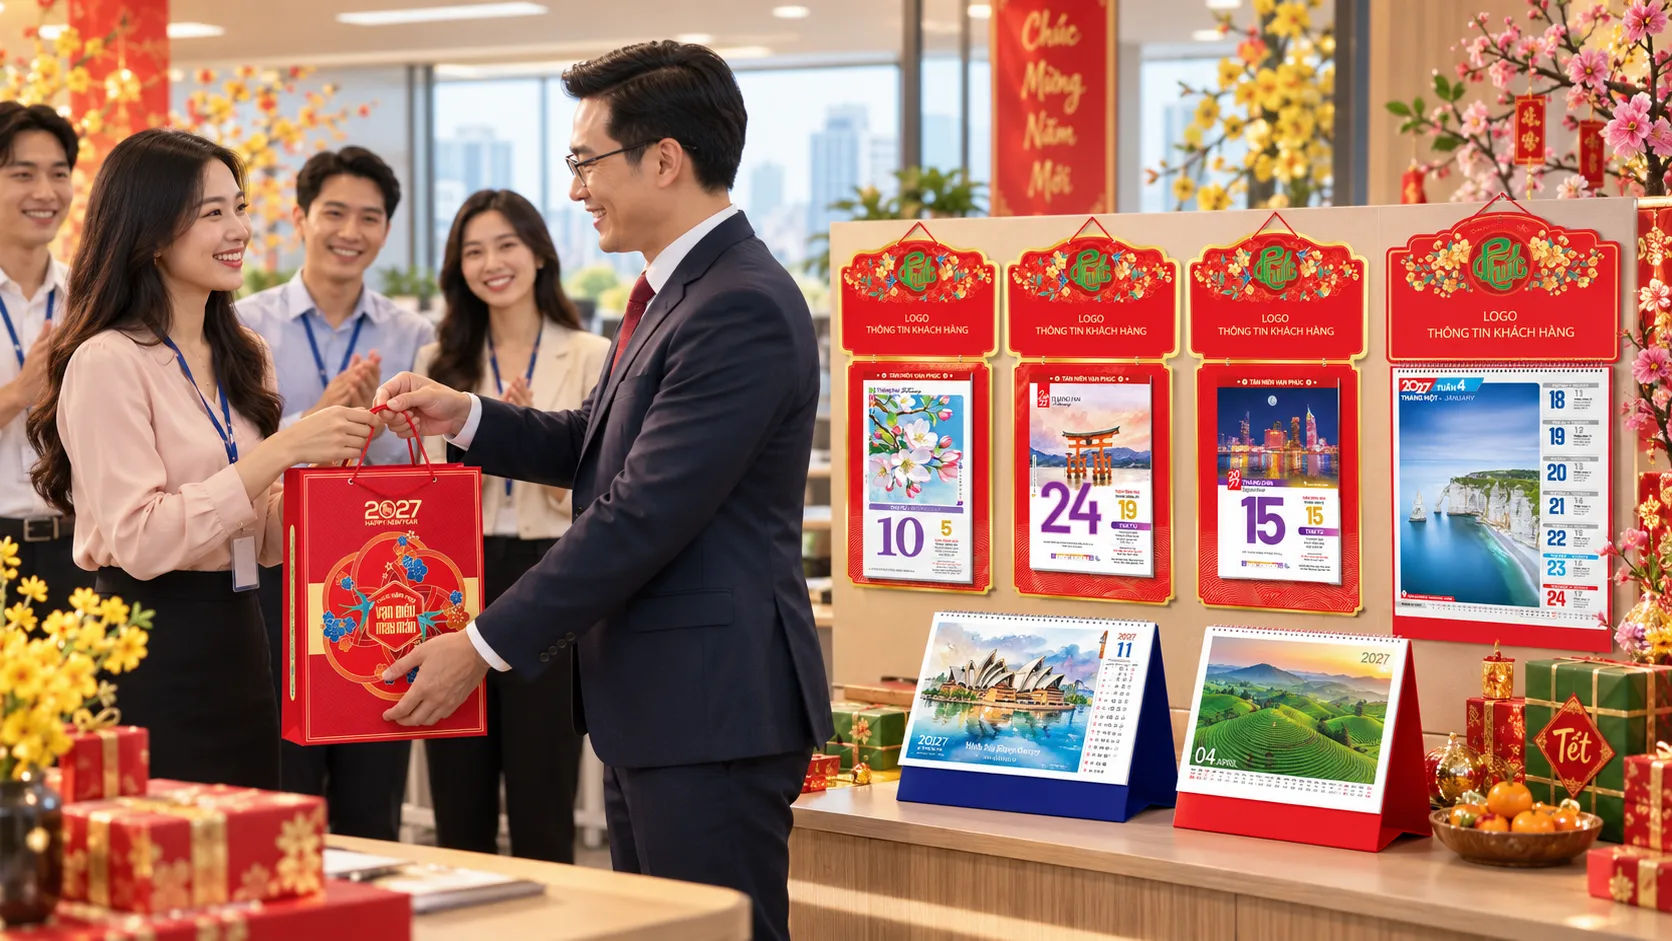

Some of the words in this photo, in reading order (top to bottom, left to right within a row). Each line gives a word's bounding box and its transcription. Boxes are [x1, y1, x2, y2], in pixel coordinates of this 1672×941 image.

[1022, 10, 1082, 52] Chúc
[1023, 110, 1078, 150] Năm
[904, 314, 929, 323] LOGO
[1078, 314, 1104, 323] LOGO
[1262, 314, 1289, 323] LOGO
[1484, 311, 1517, 322] LOGO
[866, 325, 895, 334] THÔNG
[898, 326, 910, 334] TIN
[1036, 325, 1067, 335] THÔNG
[1070, 326, 1083, 335] TIN
[1218, 326, 1251, 336] THÔNG
[1253, 327, 1268, 336] TIN
[1306, 326, 1334, 336] HÀNG
[1427, 326, 1469, 338] THÔNG
[1472, 328, 1491, 338] TIN
[1494, 325, 1536, 338] KHÁCH
[1539, 326, 1575, 338] HÀNG
[1402, 380, 1432, 394] 2027
[1457, 379, 1465, 391] 4
[1549, 390, 1566, 409] 18
[1549, 427, 1565, 445] 19
[1547, 463, 1566, 481] 20
[365, 500, 422, 519] 2027
[1041, 481, 1101, 534] 24
[1118, 500, 1137, 520] 19
[1549, 498, 1564, 514] 21
[1241, 496, 1286, 545] 15
[1306, 506, 1323, 525] 15
[941, 520, 952, 536] 5
[877, 517, 924, 557] 10
[1547, 530, 1566, 546] 22
[1547, 560, 1566, 576] 23
[1547, 590, 1566, 606] 24
[1117, 642, 1132, 657] 11
[1361, 652, 1390, 664] 2027
[1552, 728, 1592, 764] Tết
[1195, 746, 1216, 765] 04
